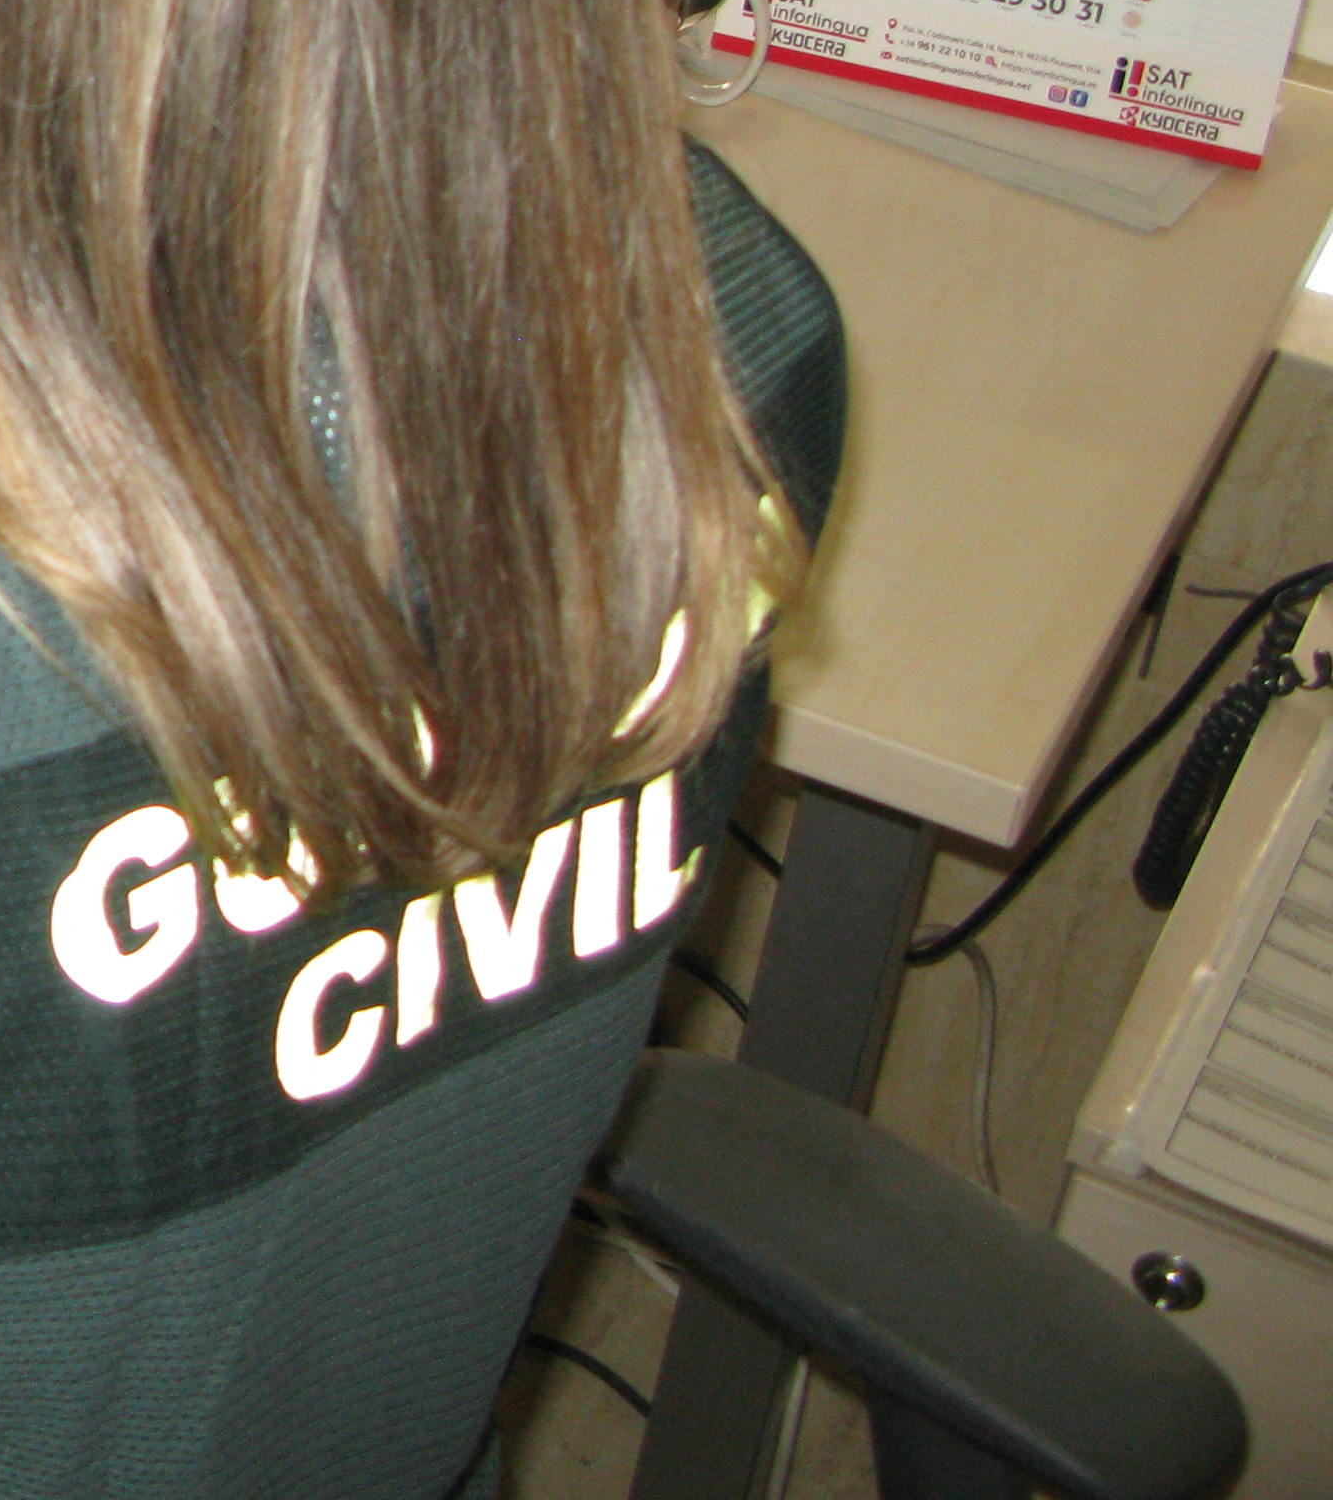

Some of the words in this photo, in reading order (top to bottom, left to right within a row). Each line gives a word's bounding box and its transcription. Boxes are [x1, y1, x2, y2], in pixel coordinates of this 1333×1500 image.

[773, 3, 869, 38] inforlingua
[917, 40, 935, 52] 961
[938, 44, 952, 56] 22
[954, 48, 967, 60] 10
[969, 52, 982, 63] 10
[1146, 64, 1192, 91] SAT
[1141, 85, 1245, 122] inforlingua
[275, 769, 704, 1101] CIVIL
